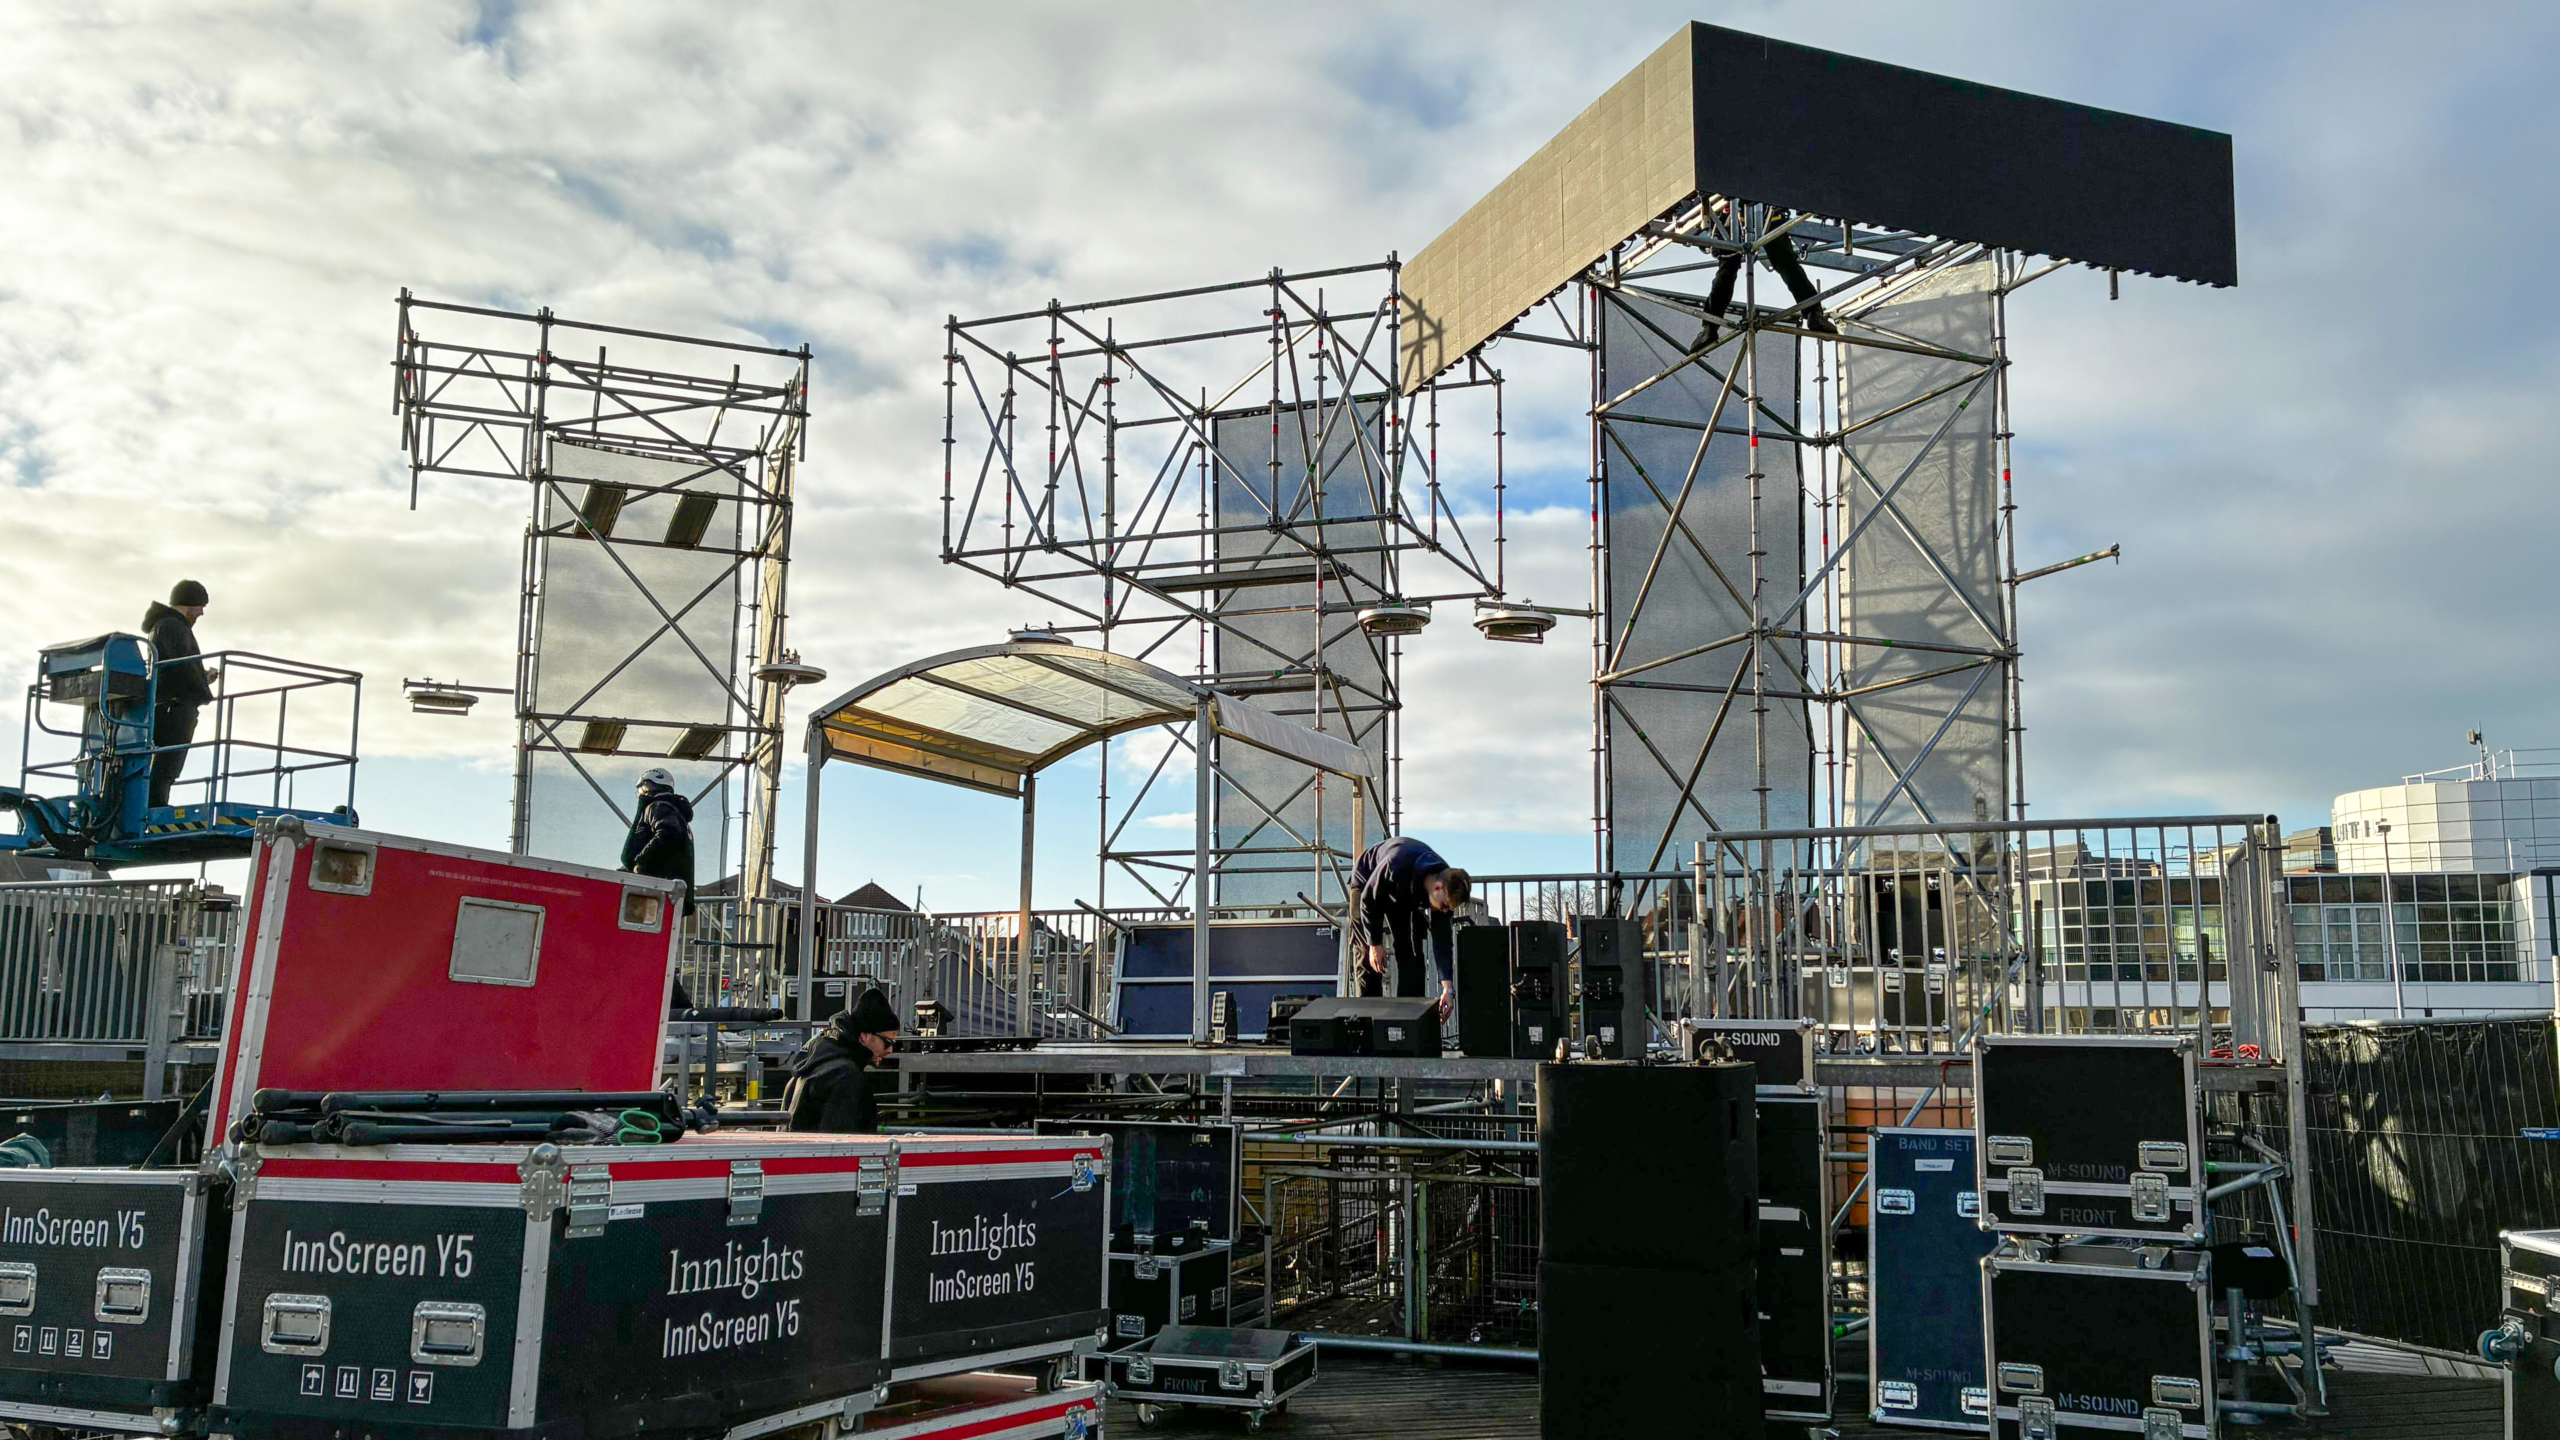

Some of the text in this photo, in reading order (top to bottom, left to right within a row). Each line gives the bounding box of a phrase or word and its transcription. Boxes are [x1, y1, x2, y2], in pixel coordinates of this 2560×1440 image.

[1899, 1137, 1972, 1152] BAND SET
[2048, 1163, 2127, 1181] M-SOUND
[3, 1206, 146, 1249] InnScreen Y5
[2060, 1208, 2117, 1226] FRONT
[930, 1212, 1036, 1261] Innlights
[282, 1230, 474, 1278] InnScreen Y5
[666, 1236, 804, 1300] Innlights
[929, 1262, 1035, 1304] InnScreen Y5
[662, 1299, 800, 1359] InnScreen Y5
[1164, 1377, 1208, 1393] FRONT
[1906, 1366, 1972, 1384] M-SOUND
[2058, 1392, 2139, 1415] M-SOUND
